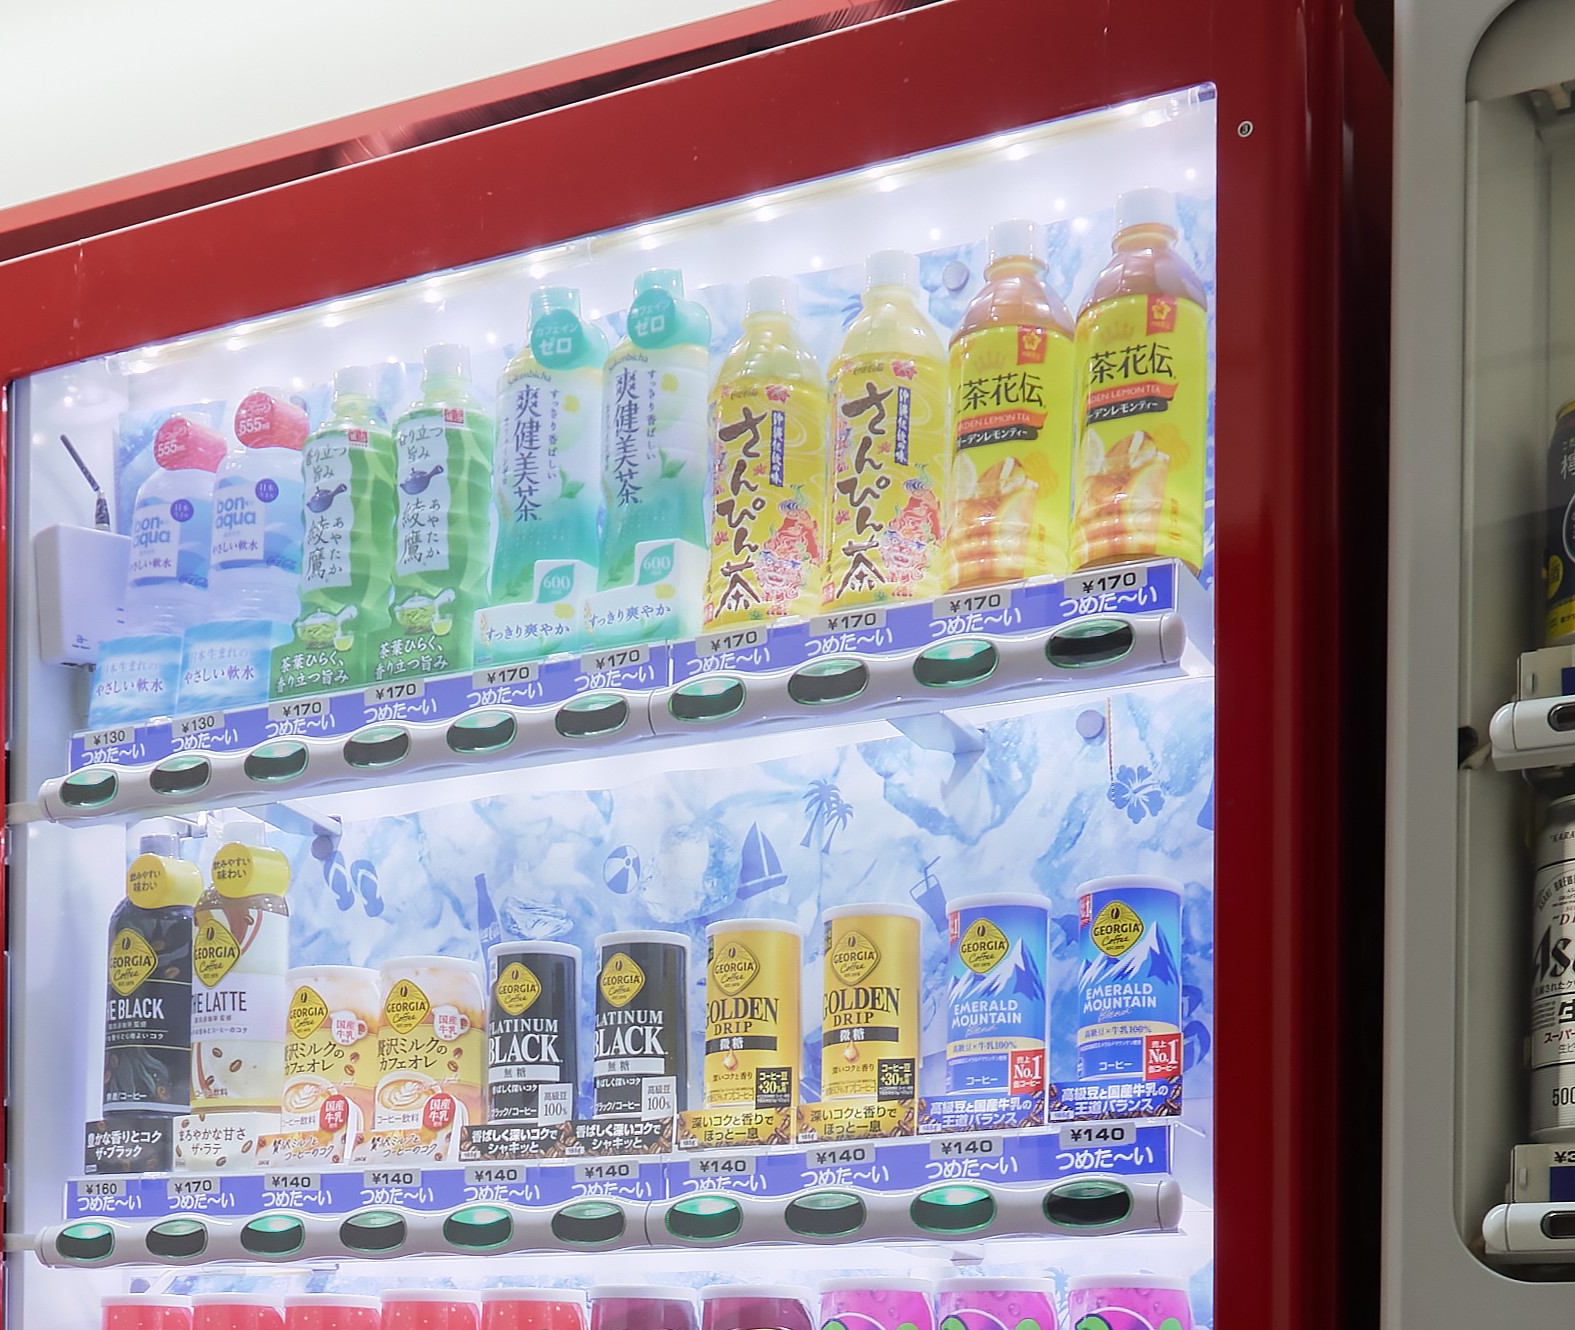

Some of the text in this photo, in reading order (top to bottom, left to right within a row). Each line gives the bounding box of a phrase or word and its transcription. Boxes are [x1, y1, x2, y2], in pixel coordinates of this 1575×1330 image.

[539, 337, 572, 356] ゼロ
[1089, 343, 1174, 383] 茶花伝
[512, 384, 541, 522] 爽健美茶
[835, 382, 894, 597] さんぴん茶
[1083, 571, 1136, 592] ¥170
[827, 612, 876, 630] ¥170
[595, 649, 640, 667] ¥170
[184, 664, 255, 683] やさしい軟水
[375, 683, 417, 698] ¥170
[181, 715, 215, 732] ¥130
[217, 867, 247, 880] 味わい
[1094, 924, 1140, 937] GEORGIA
[1085, 983, 1152, 1000] EMERALD
[120, 999, 164, 1019] BLACK
[206, 991, 247, 1012] LATTE
[1083, 995, 1156, 1013] MOUNTAIN
[706, 997, 779, 1029] GOLDEN
[715, 1022, 752, 1034] DRIP
[720, 1037, 744, 1049] 微糖
[379, 1053, 436, 1072] カフェオレ
[1149, 1047, 1178, 1065] No.1
[1061, 1085, 1169, 1100] 高級豆と国産牛乳の
[1075, 1099, 1153, 1113] 王道バランス
[692, 1114, 773, 1127] 深いコクと香りで
[87, 1130, 162, 1147] 豊かな香りとコク
[178, 1127, 247, 1143] まろやかな甘さ
[704, 1127, 758, 1141] ほっと一息
[1071, 1126, 1124, 1141] ¥140
[488, 1140, 539, 1153] シャキッと
[700, 1160, 746, 1172] ¥140
[272, 1174, 312, 1190] ¥140
[475, 1169, 517, 1182] ¥140
[86, 1182, 117, 1196] ¥160
[175, 1179, 213, 1194] ¥170
